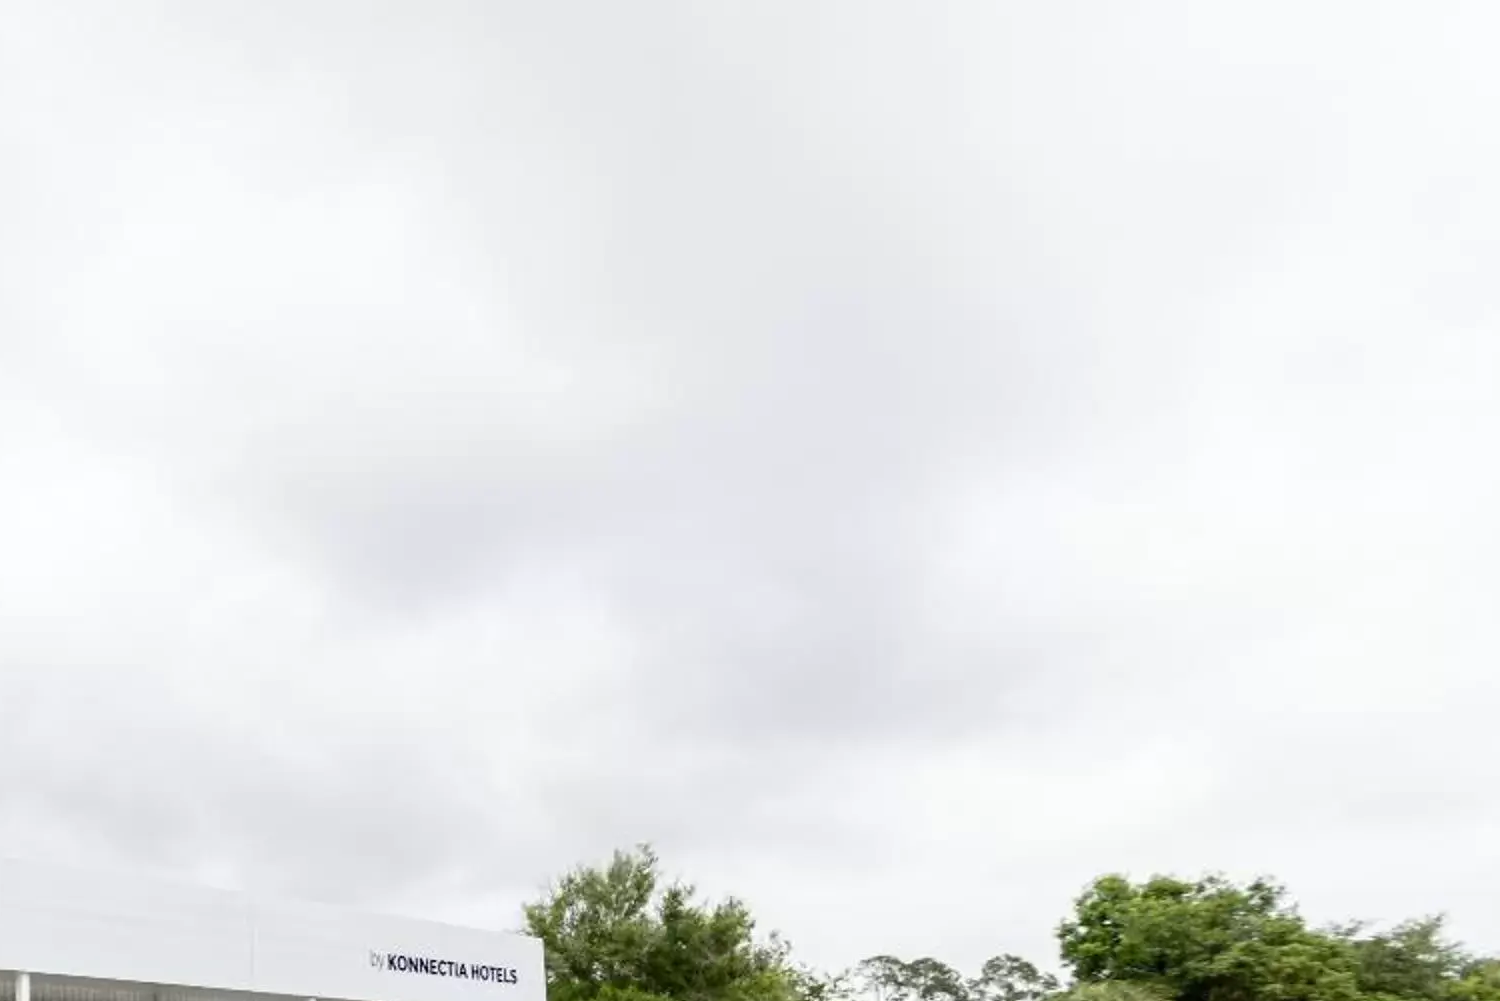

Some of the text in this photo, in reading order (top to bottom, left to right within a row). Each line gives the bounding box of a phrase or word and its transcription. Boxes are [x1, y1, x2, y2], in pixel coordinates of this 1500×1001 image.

[370, 950, 518, 984] by KONNECTIA HOTELS
